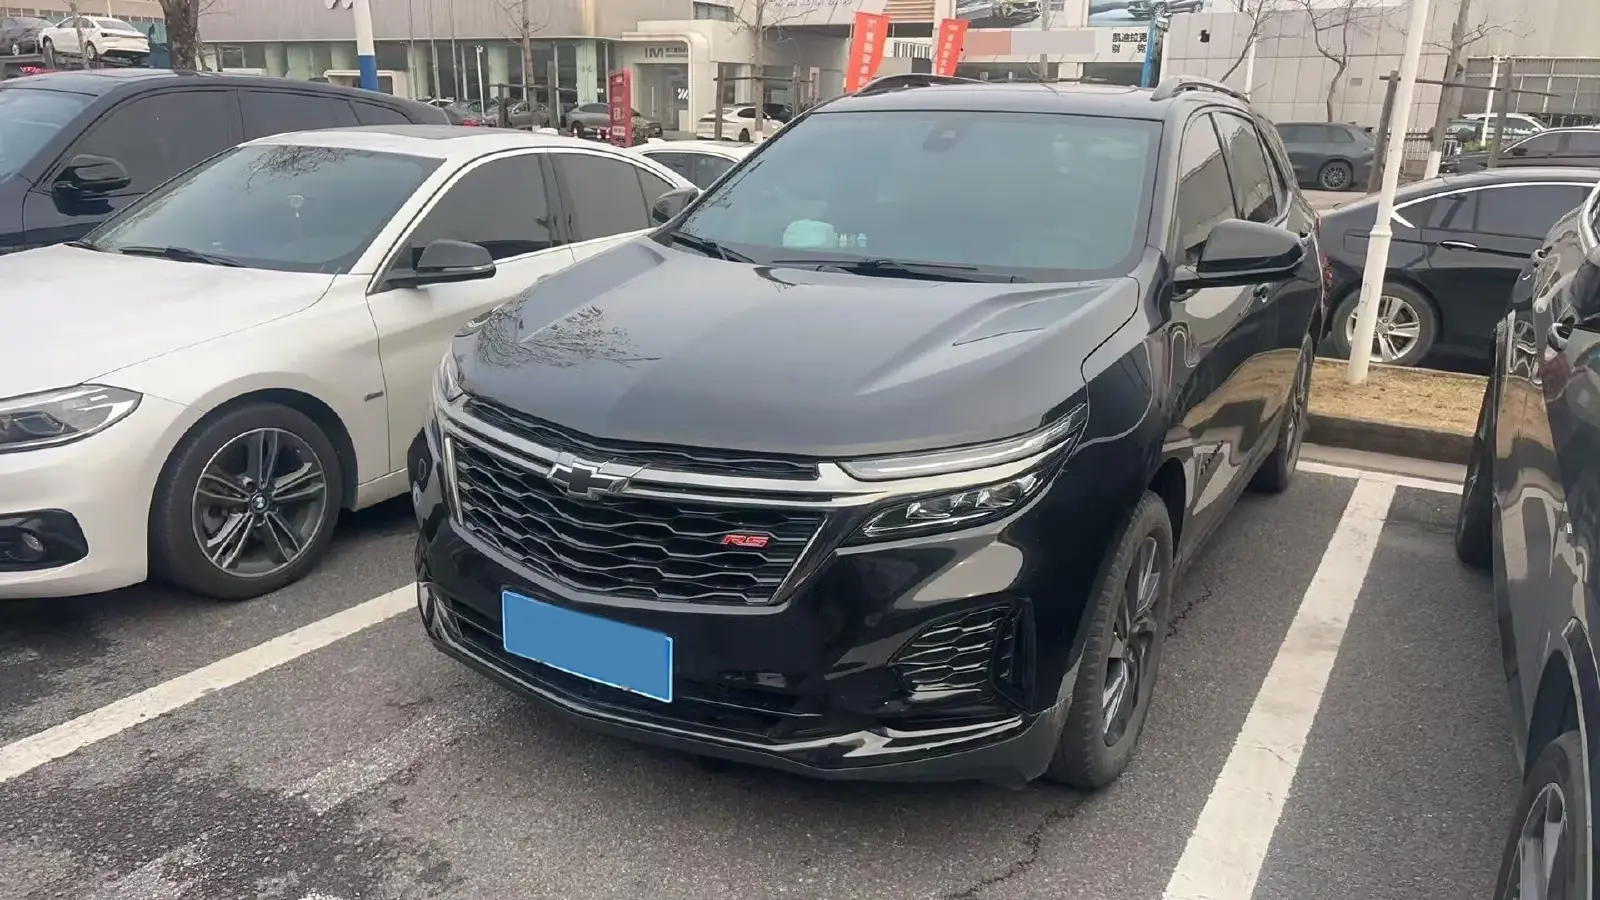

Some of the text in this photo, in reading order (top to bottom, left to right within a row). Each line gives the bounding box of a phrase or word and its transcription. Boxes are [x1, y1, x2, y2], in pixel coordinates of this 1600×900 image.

[1112, 33, 1147, 42] 凯迪拉克
[721, 534, 770, 547] RS
